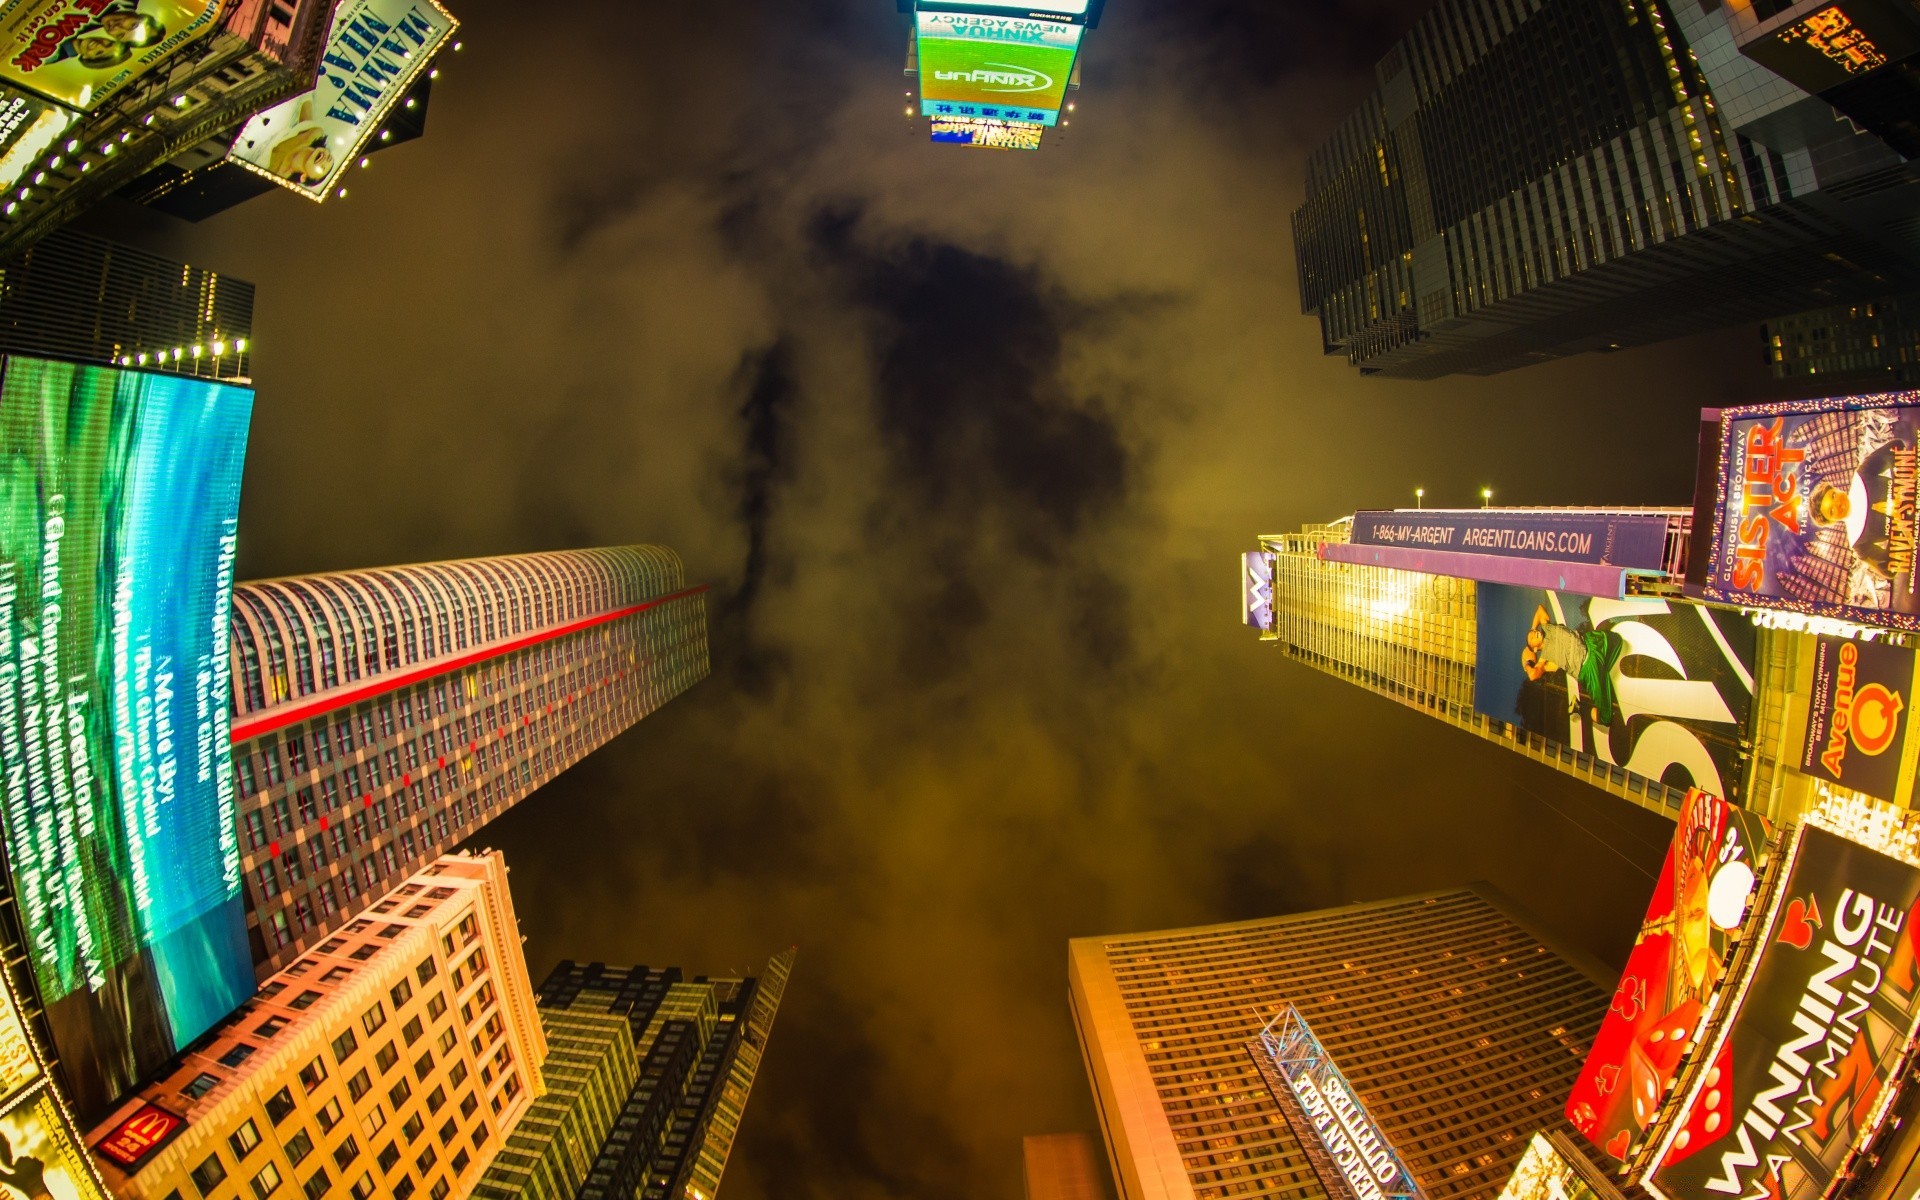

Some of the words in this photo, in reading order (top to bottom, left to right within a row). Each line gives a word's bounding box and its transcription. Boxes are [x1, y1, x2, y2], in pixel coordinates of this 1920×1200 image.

[15, 30, 29, 44] It
[22, 15, 46, 36] Get
[41, 0, 68, 20] Can
[929, 14, 1008, 27] AGENCY
[951, 24, 1044, 42] XINHUA
[1013, 20, 1066, 33] NEWS
[11, 15, 90, 73] WORK
[137, 28, 191, 67] BRODERICK
[314, 4, 392, 91] MIA!
[325, 5, 437, 126] MAMMA
[396, 47, 425, 81] ANDERSSON
[935, 104, 1044, 120] 新华通讯社
[1731, 417, 1784, 592] SISTER
[1766, 438, 1806, 534] ACT
[1802, 445, 1813, 506] MUSICAL
[1723, 502, 1740, 581] GLORIOUSLY
[1733, 429, 1747, 498] BROADWAY
[1799, 508, 1808, 534] THE
[42, 517, 64, 598] Grand
[1372, 524, 1455, 544] 1-866-MY-ARGENT
[1462, 527, 1591, 554] ARGENTLOANS.COM
[210, 533, 237, 698] Photography
[1250, 567, 1265, 611] W
[19, 636, 41, 698] Zion
[40, 603, 59, 697] Canyon
[134, 647, 150, 691] The
[155, 673, 172, 754] Music
[1819, 671, 1830, 714] MUSICAL
[1822, 642, 1858, 778] Avenue
[1849, 682, 1904, 755] Q
[23, 704, 49, 806] National
[45, 702, 70, 803] National
[213, 708, 232, 756] and
[1805, 710, 1818, 766] BROADWAY'S
[1815, 716, 1824, 741] BEST
[67, 691, 96, 837] Locations
[215, 761, 231, 850] Editing
[4, 762, 37, 867] National
[34, 926, 60, 964] UT
[44, 871, 68, 906] UT
[1705, 888, 1876, 1194] WINNING
[1764, 1085, 1825, 1181] ANY
[1817, 902, 1904, 1080] MINUTE
[33, 1103, 59, 1148] HUMAN
[1291, 1072, 1333, 1129] EAGLE
[104, 1142, 135, 1162] HOURS
[1321, 1076, 1395, 1184] OUTFITTERS
